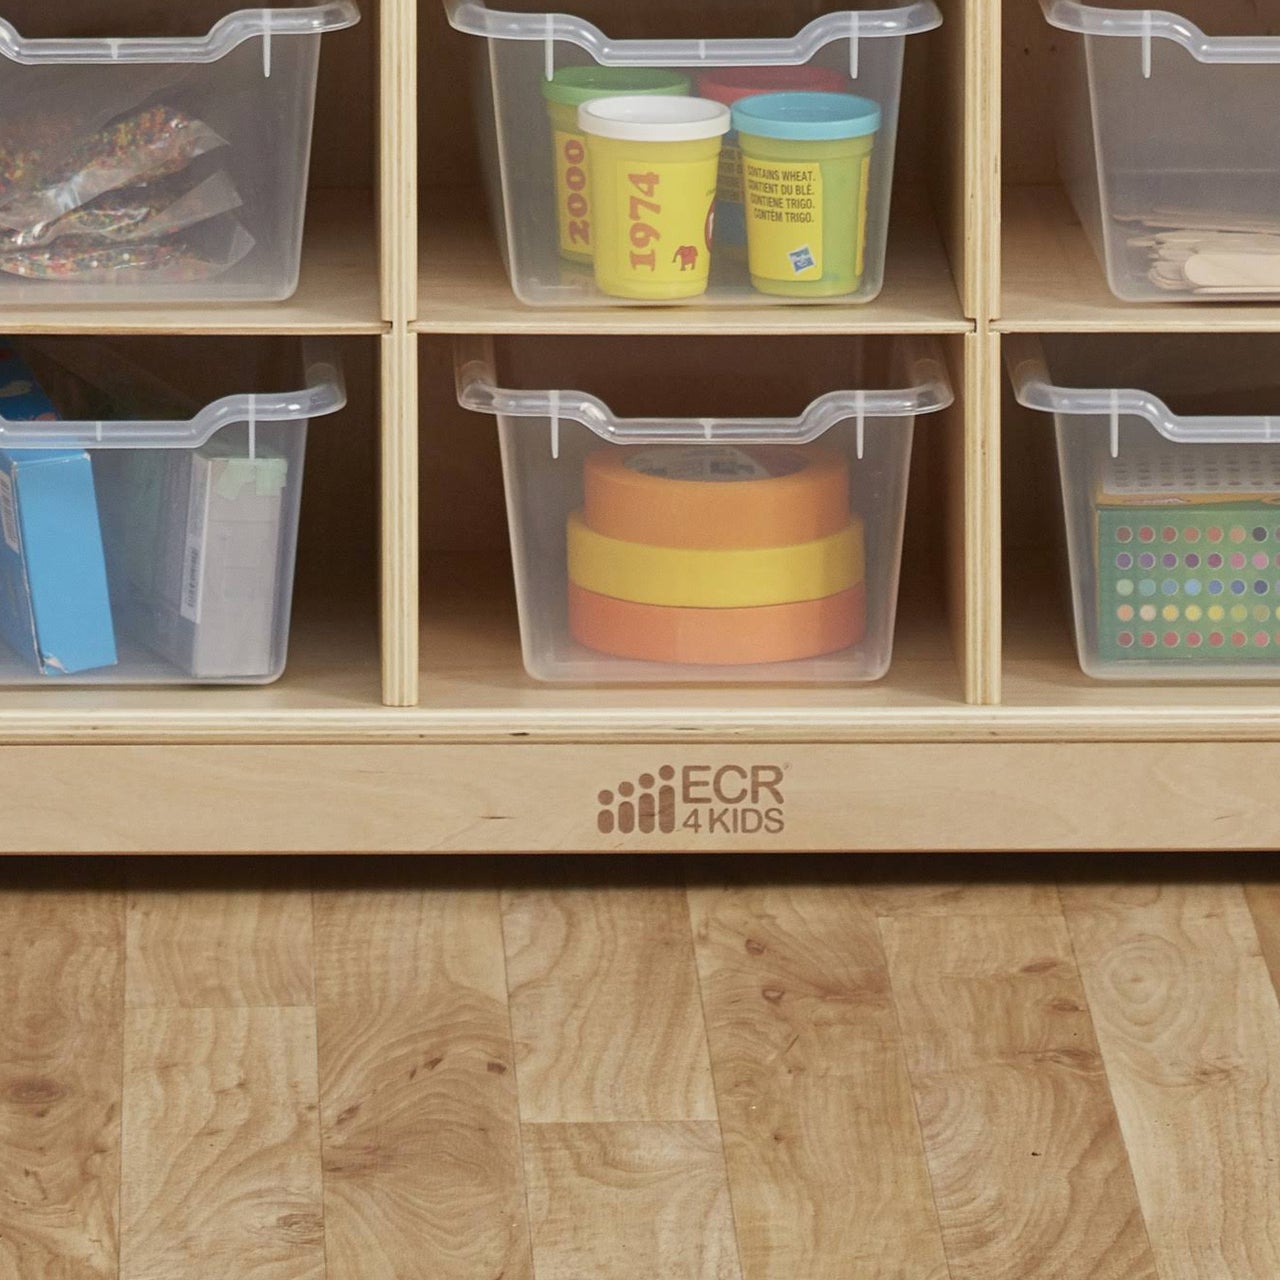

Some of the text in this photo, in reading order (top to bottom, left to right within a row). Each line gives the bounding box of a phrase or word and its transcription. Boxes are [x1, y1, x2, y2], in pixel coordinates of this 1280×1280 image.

[782, 170, 817, 182] WHEAT.
[563, 138, 592, 247] 2000
[786, 198, 816, 210] TRIGO.
[627, 170, 662, 273] 1974
[785, 212, 815, 224] TRIGO.
[681, 764, 785, 805] ECR
